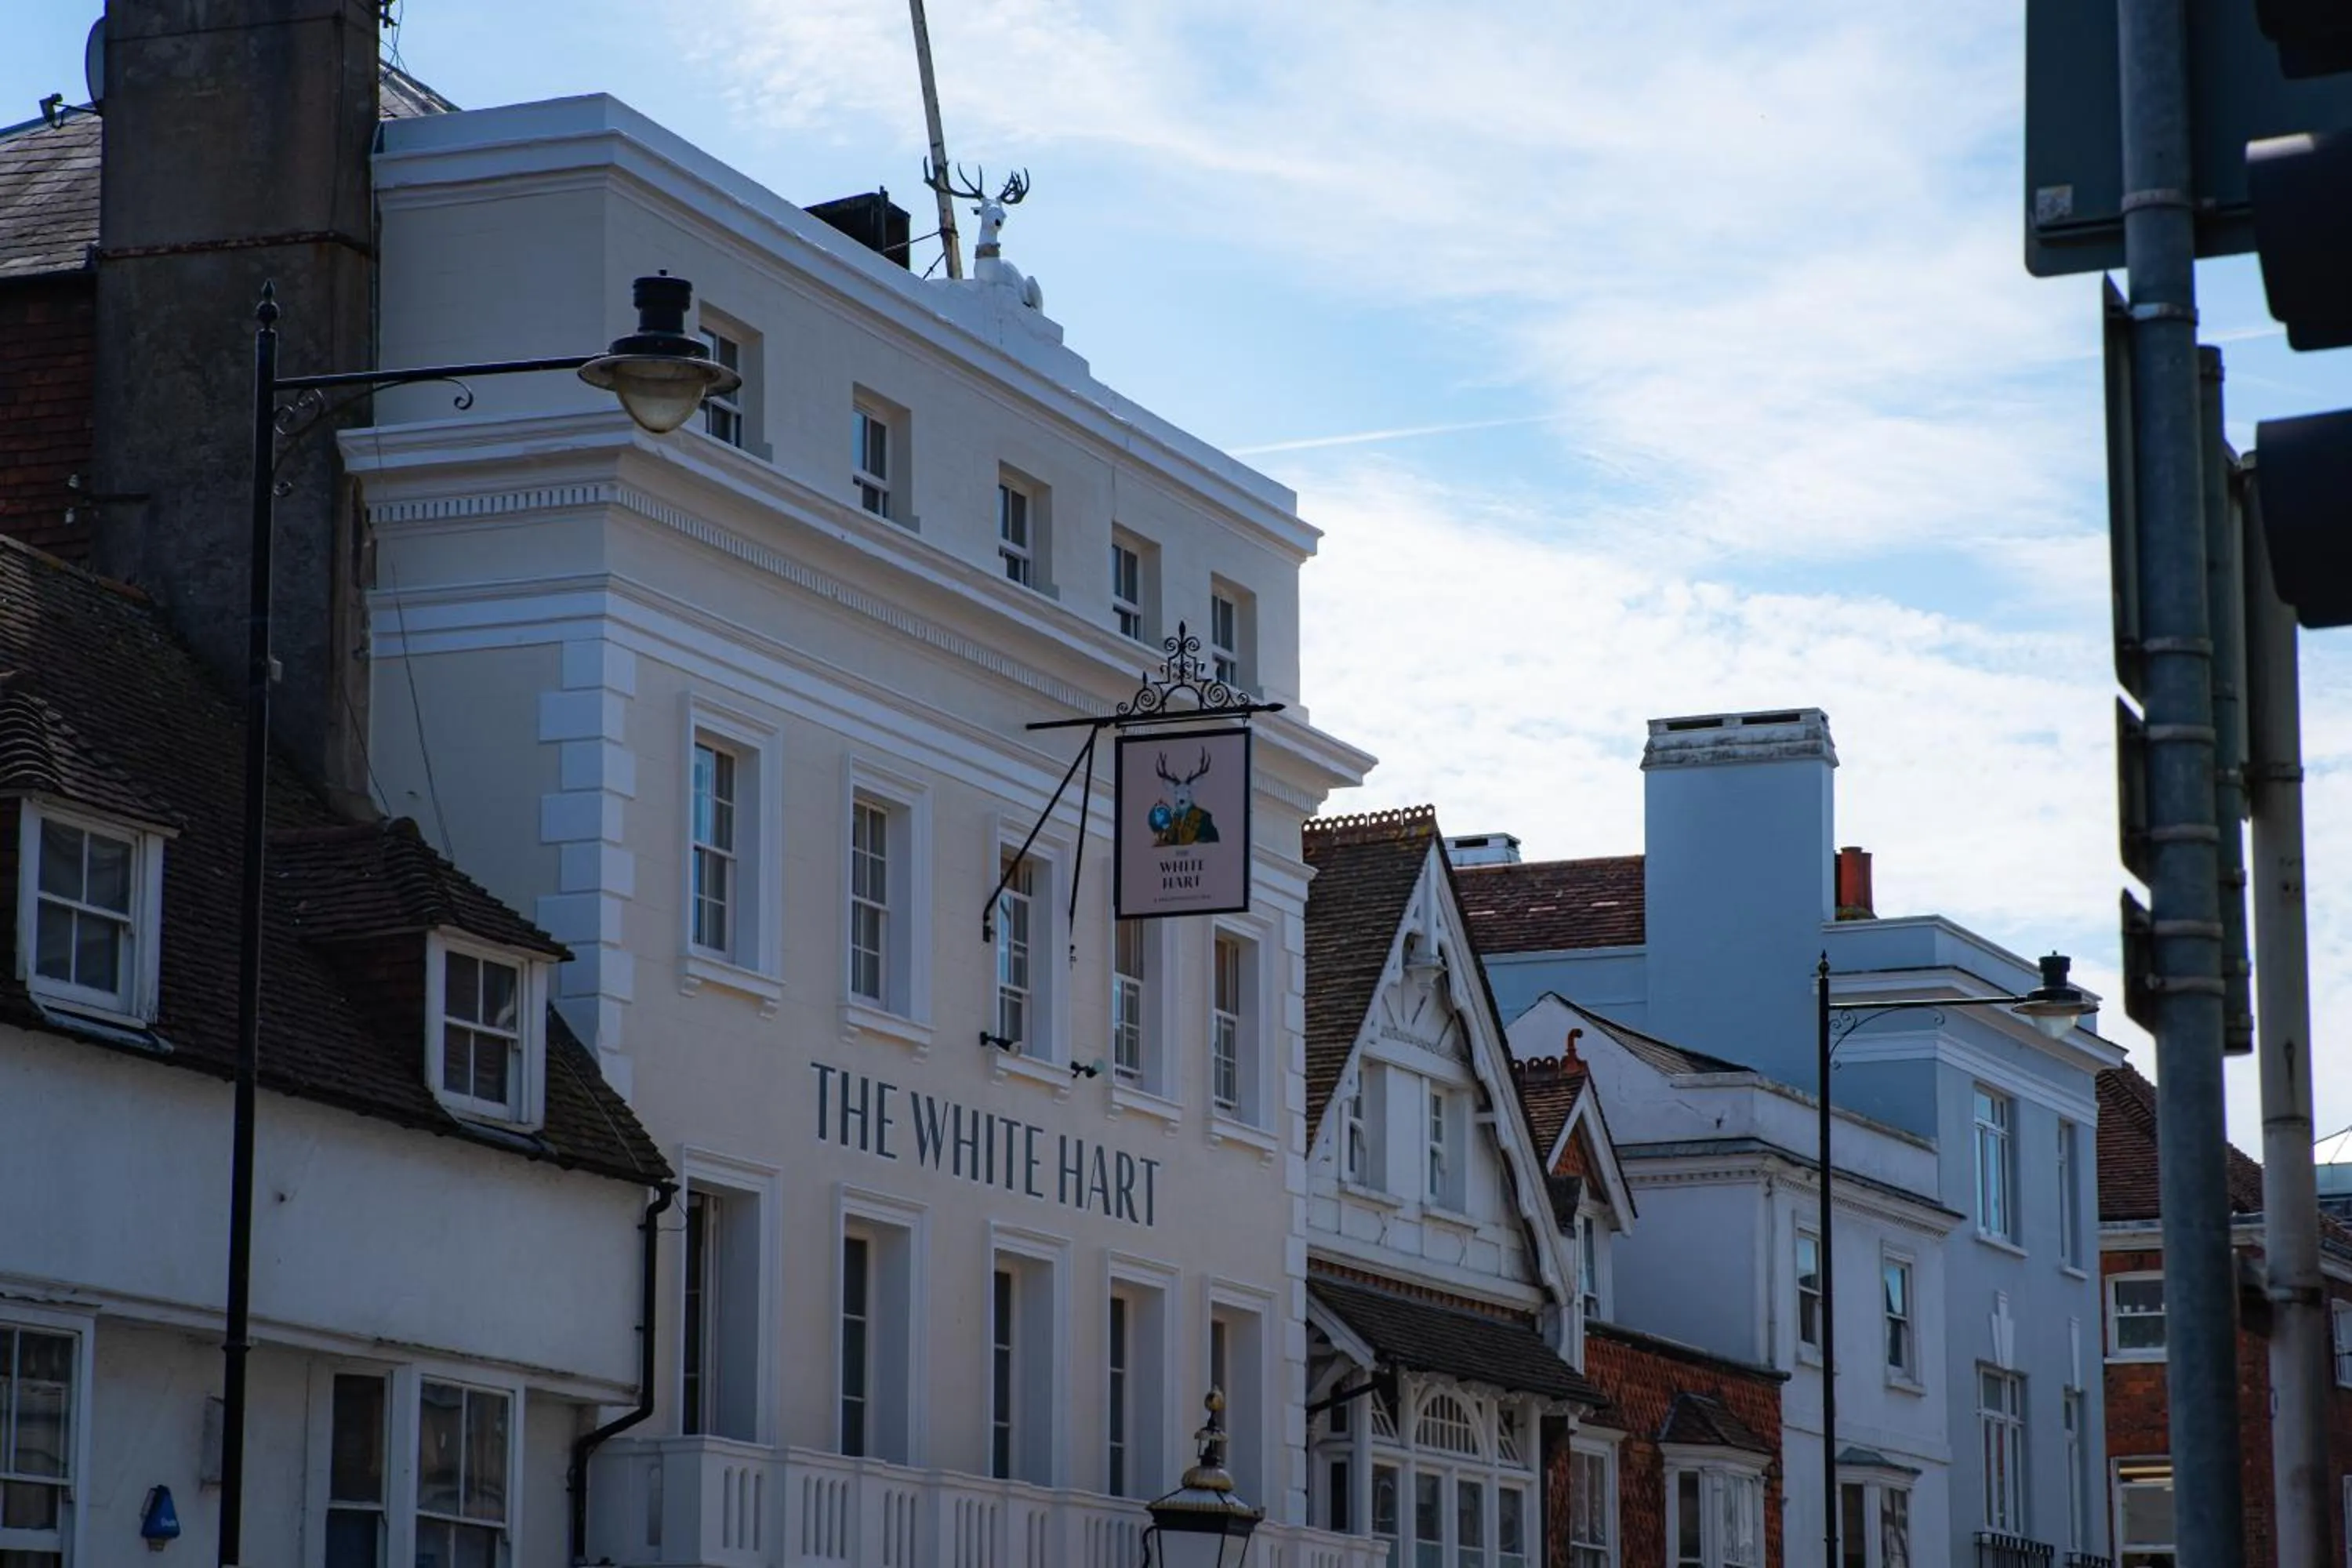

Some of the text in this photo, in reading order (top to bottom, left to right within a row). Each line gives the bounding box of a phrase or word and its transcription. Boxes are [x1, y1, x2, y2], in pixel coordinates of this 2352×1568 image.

[1160, 859, 1205, 873] WHITE
[1162, 875, 1200, 891] HART
[810, 1062, 1160, 1227] THE WHITE HART
